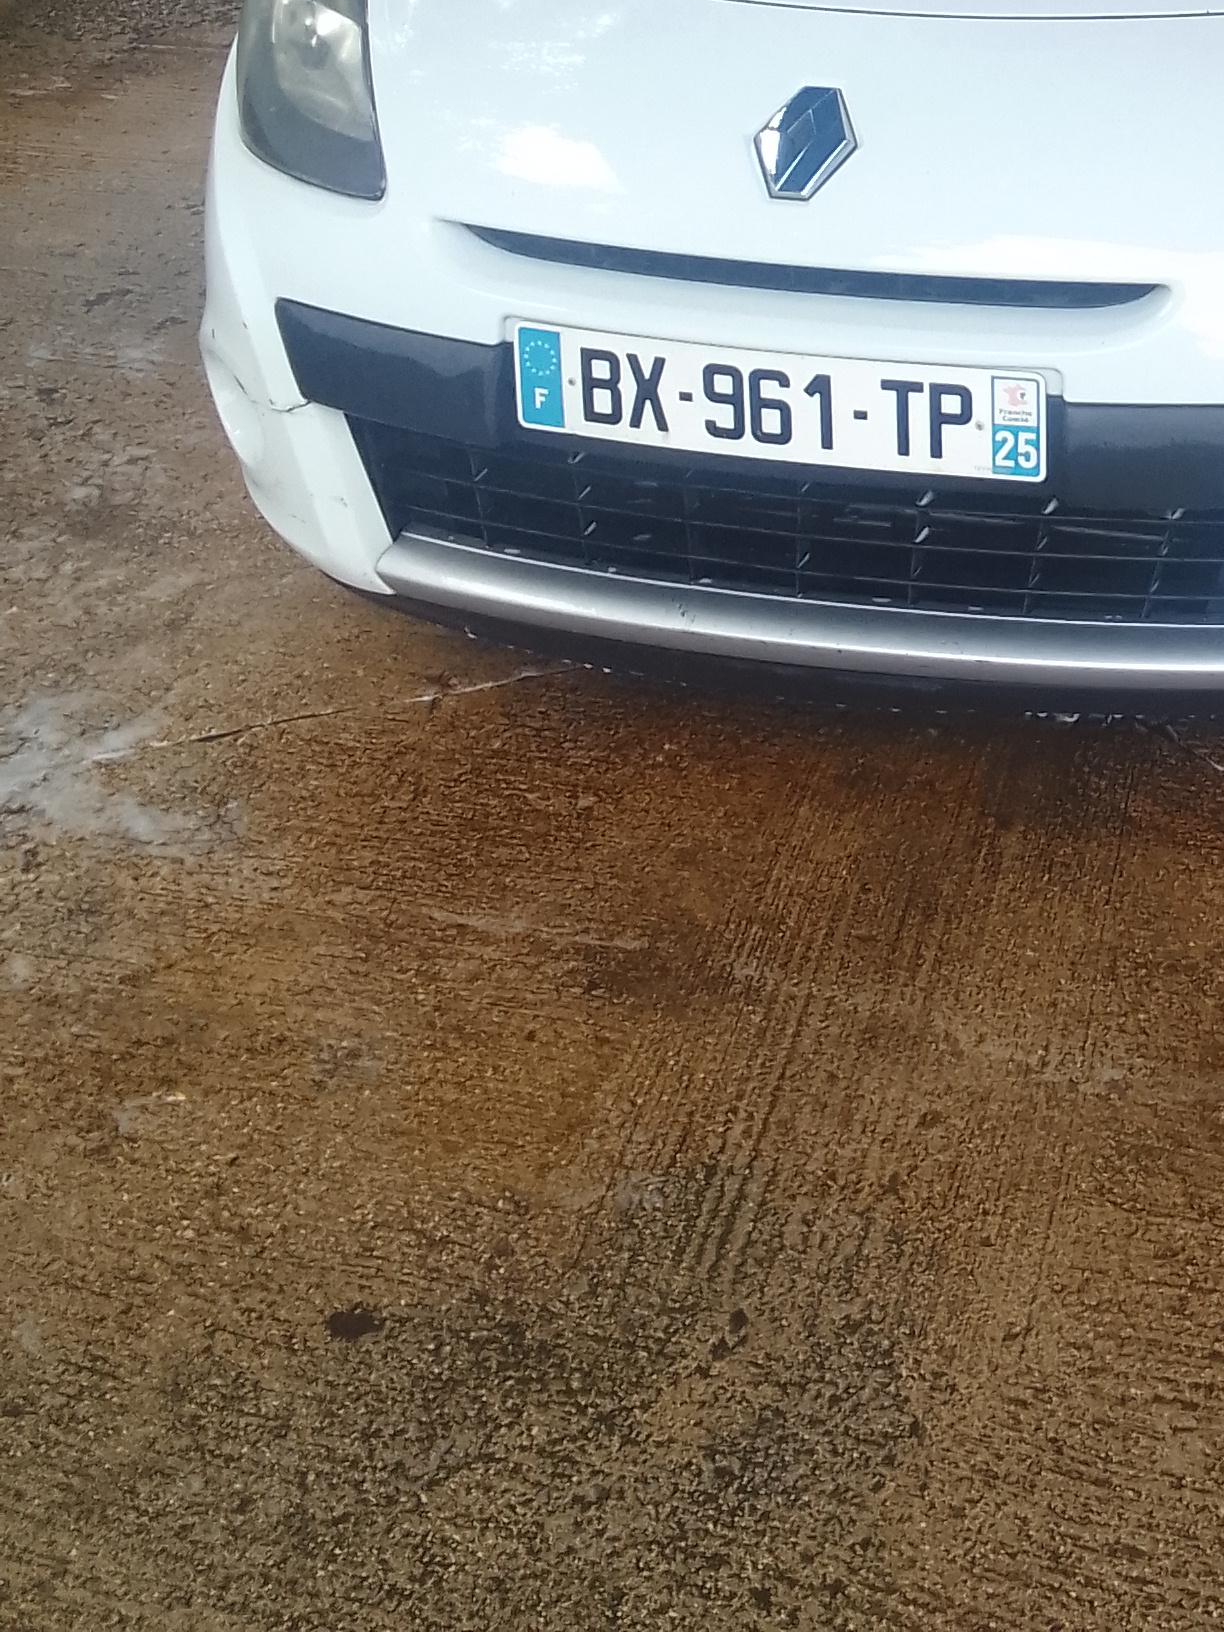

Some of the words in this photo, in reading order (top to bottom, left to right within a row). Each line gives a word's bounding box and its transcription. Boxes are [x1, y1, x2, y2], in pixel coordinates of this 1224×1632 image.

[533, 387, 550, 410] F
[579, 346, 973, 459] BX-961-TP
[993, 429, 1038, 470] 25
